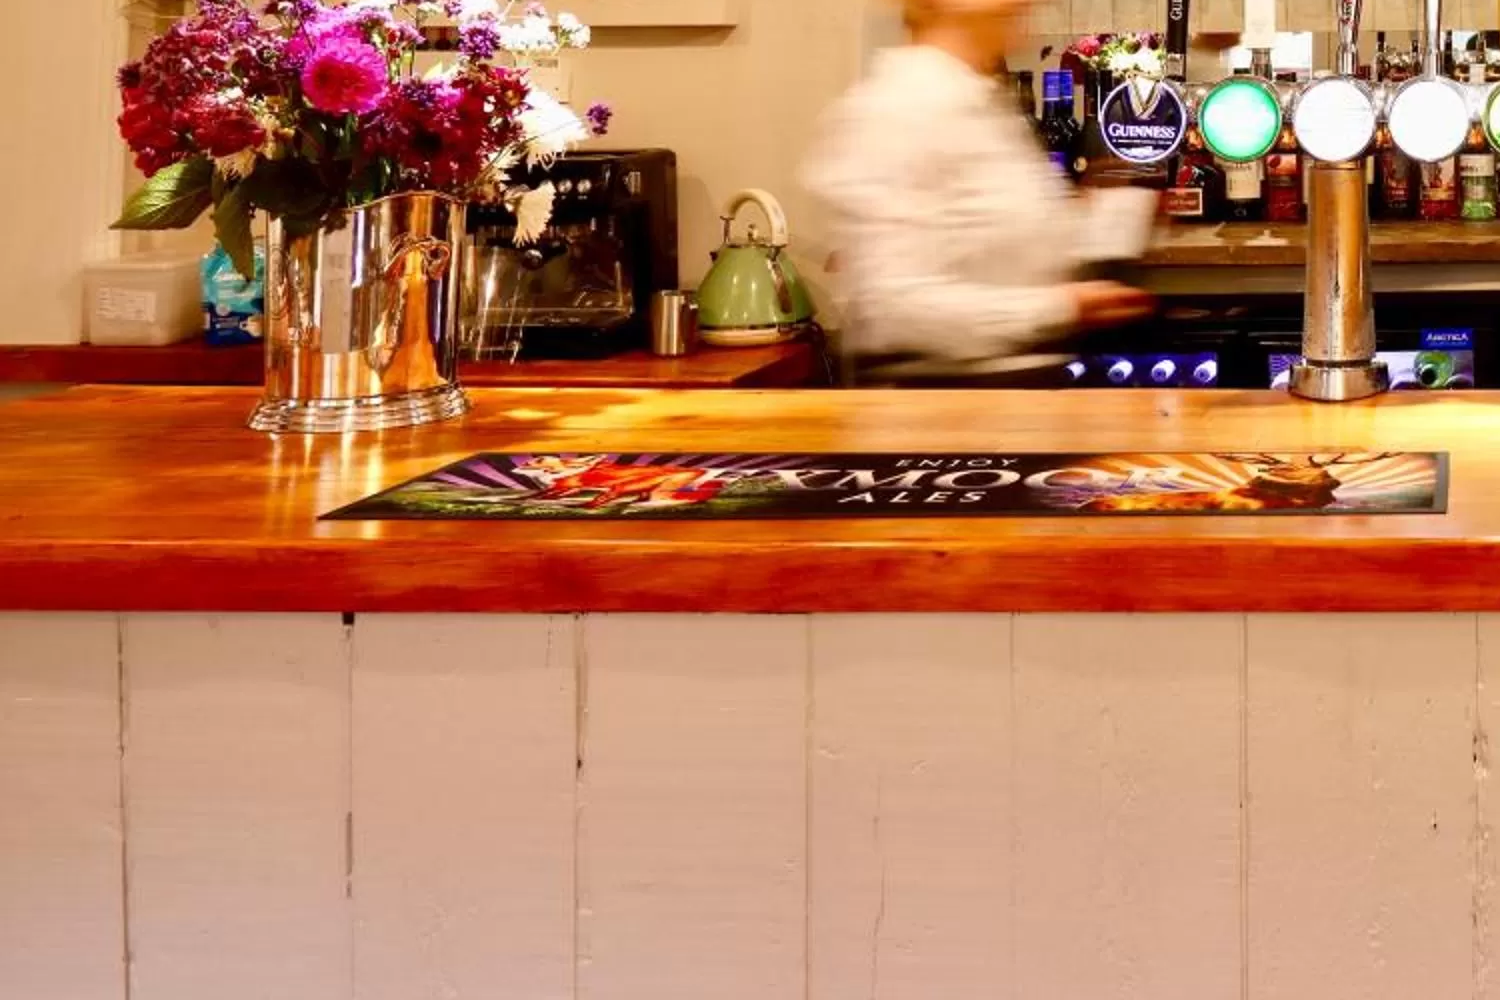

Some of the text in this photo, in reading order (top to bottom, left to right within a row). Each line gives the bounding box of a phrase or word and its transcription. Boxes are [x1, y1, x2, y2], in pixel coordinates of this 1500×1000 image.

[1108, 123, 1176, 139] GUINNESS
[896, 458, 1019, 468] ENJOY
[691, 466, 1198, 490] EXMOOR
[837, 491, 989, 503] ALES
